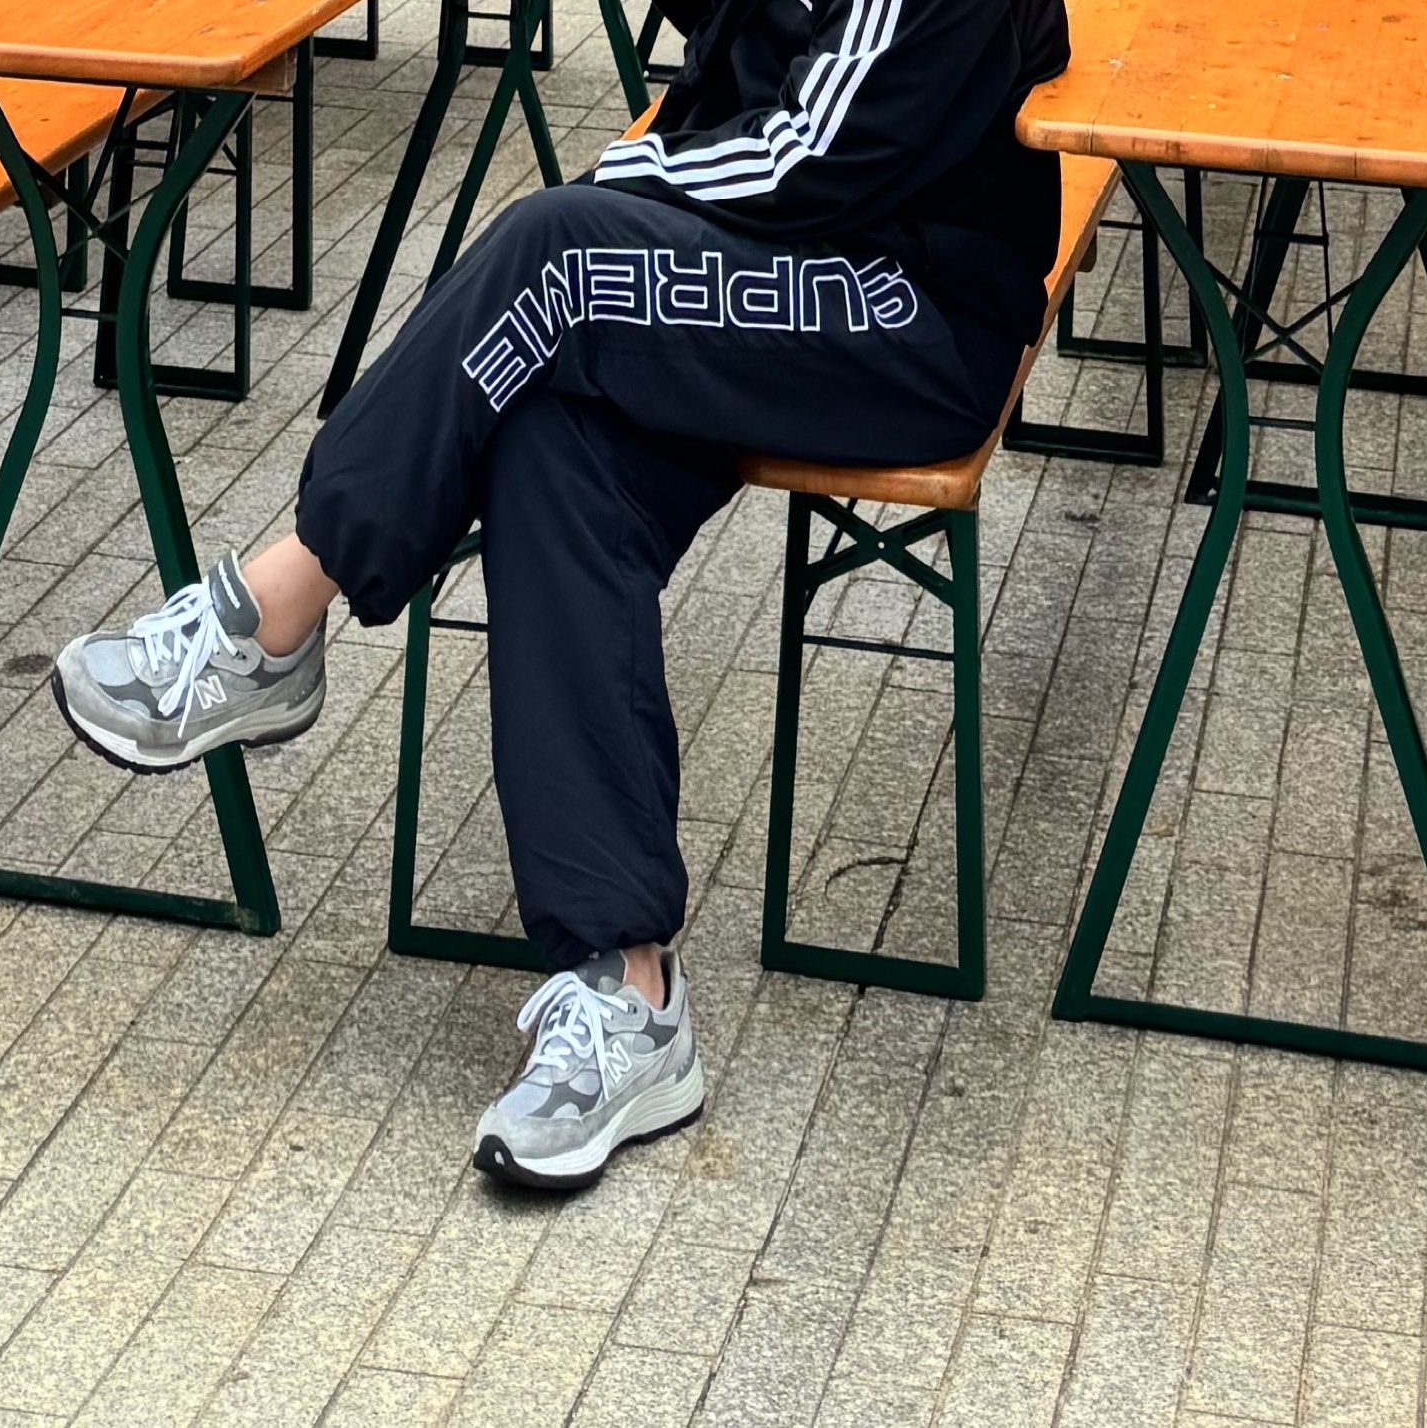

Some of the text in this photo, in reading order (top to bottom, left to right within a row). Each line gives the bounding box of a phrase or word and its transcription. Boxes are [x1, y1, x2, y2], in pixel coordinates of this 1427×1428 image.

[461, 248, 918, 413] SUPREME
[194, 674, 228, 710] N
[605, 1039, 633, 1084] N
